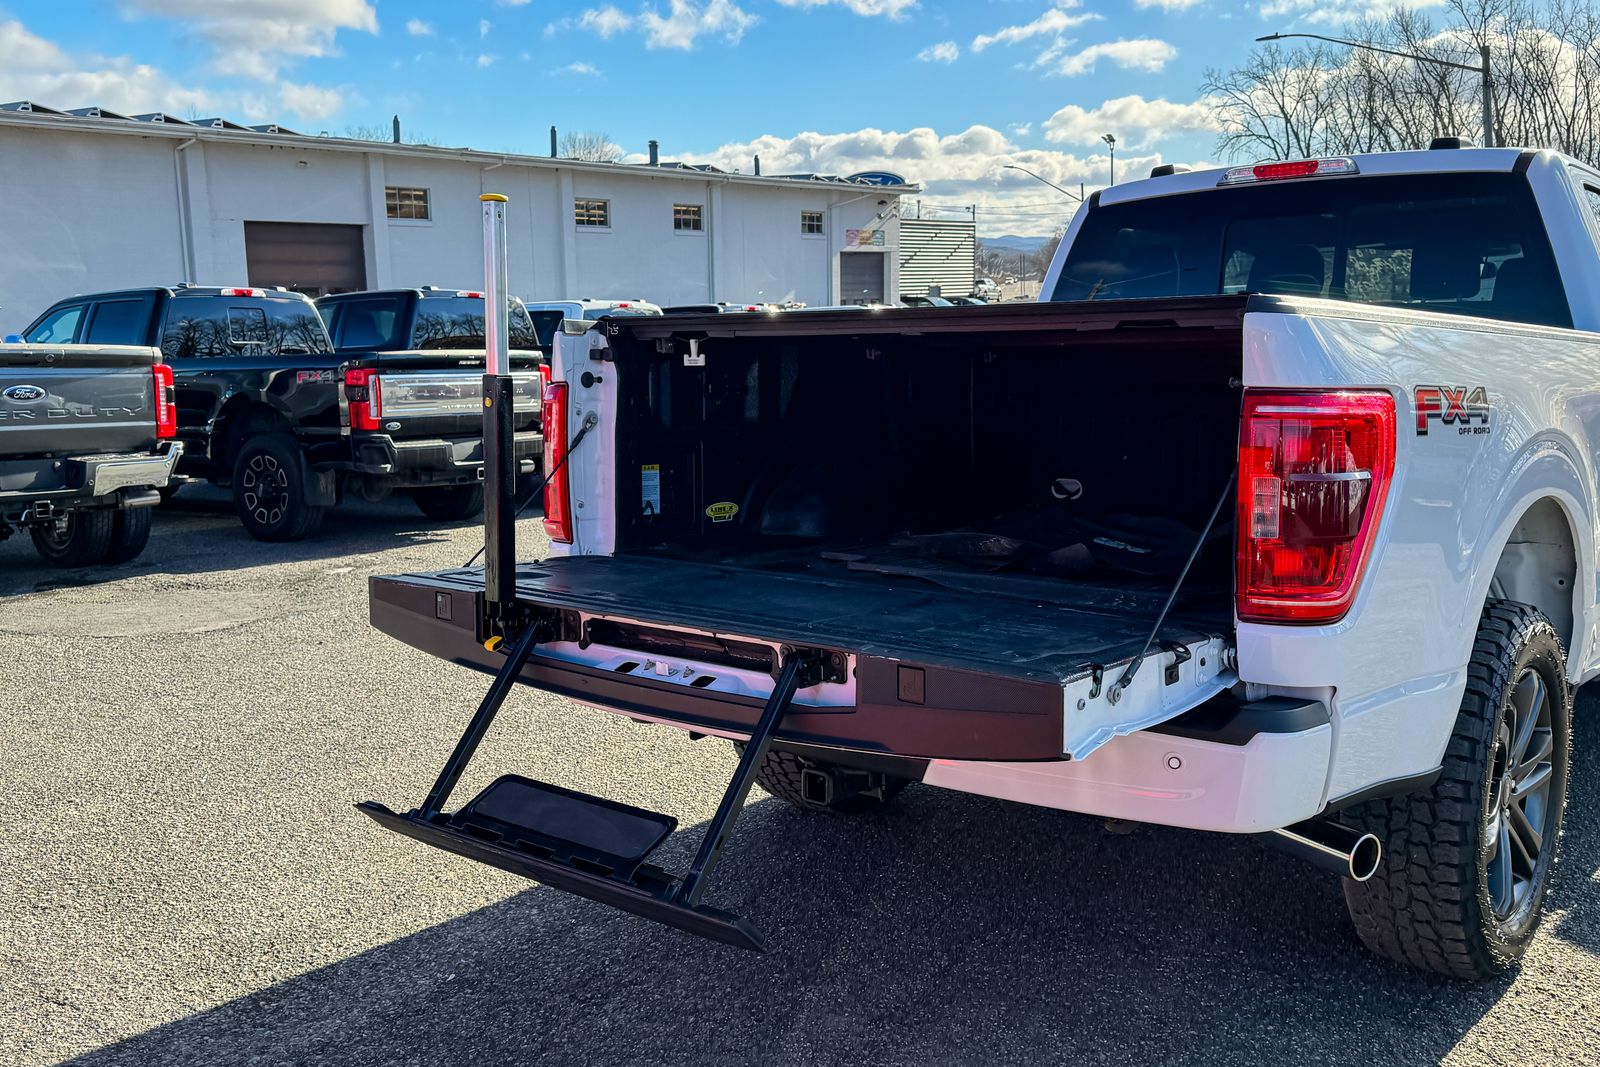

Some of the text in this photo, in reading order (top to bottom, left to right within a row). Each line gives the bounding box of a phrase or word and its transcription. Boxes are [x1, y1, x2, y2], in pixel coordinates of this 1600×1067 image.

[13, 388, 37, 399] Ford
[47, 407, 143, 418] DUTY
[1414, 385, 1490, 436] FX4
[1458, 427, 1491, 435] OFF ROAD
